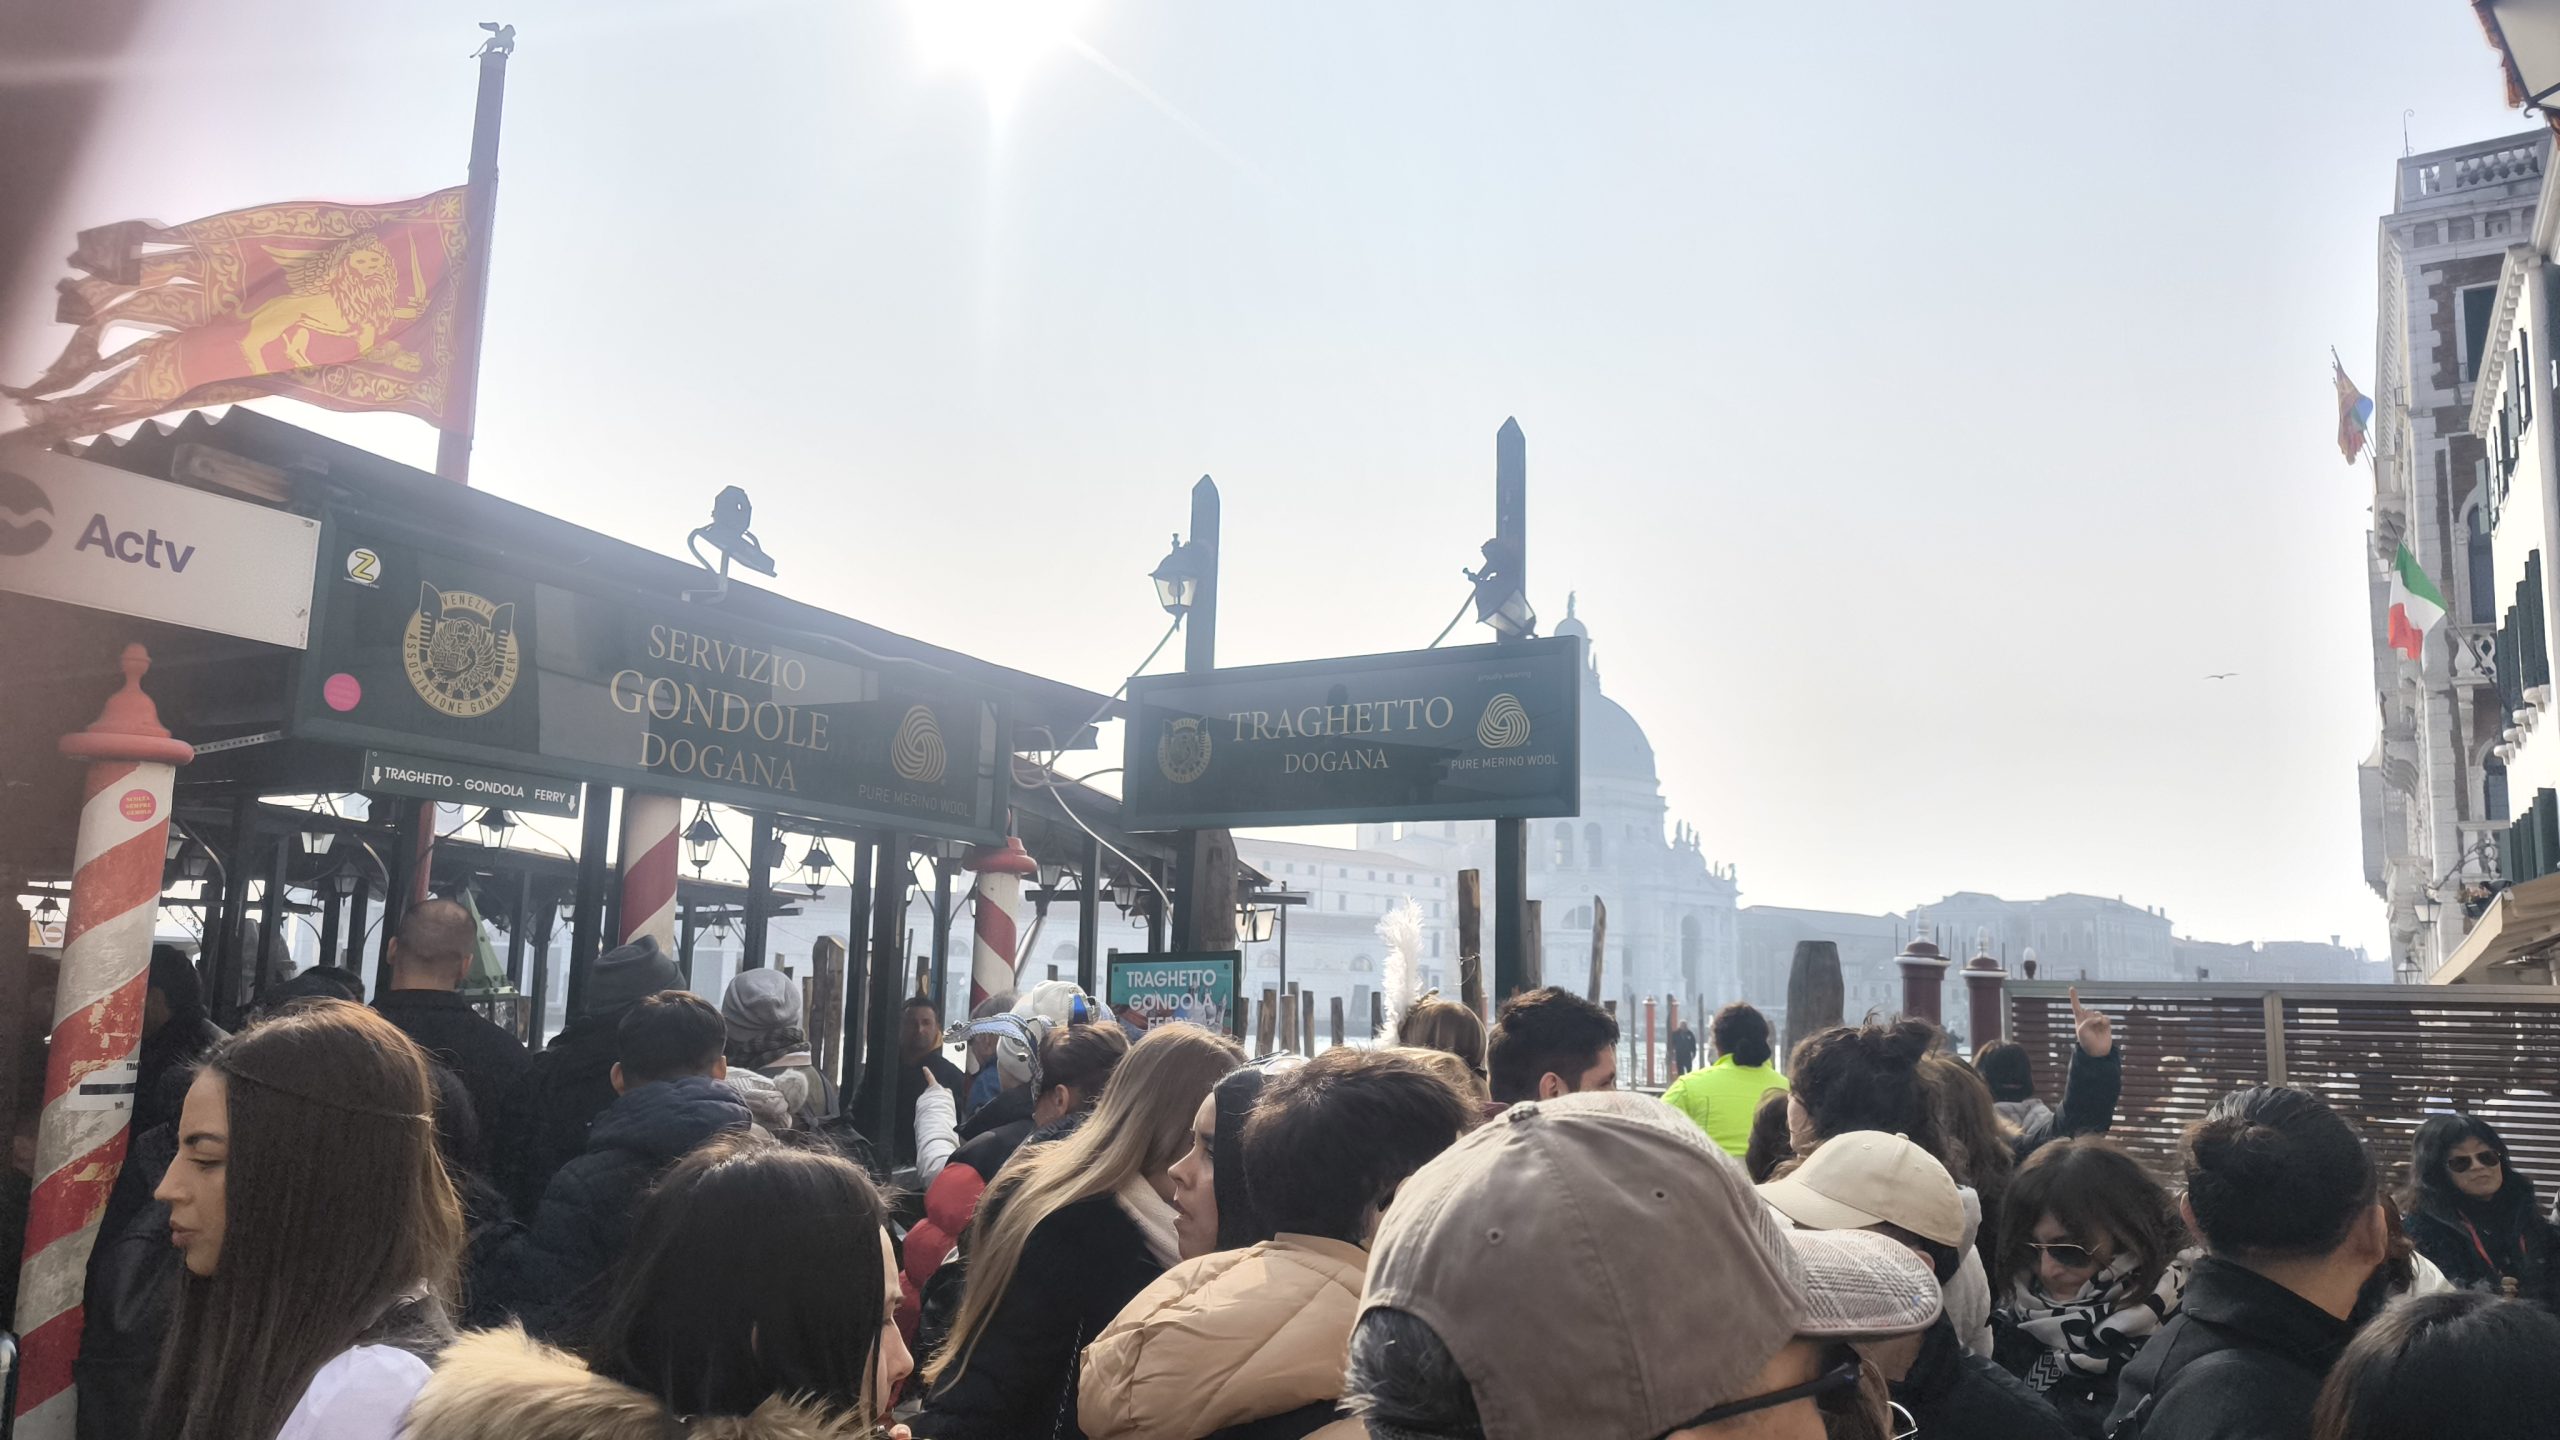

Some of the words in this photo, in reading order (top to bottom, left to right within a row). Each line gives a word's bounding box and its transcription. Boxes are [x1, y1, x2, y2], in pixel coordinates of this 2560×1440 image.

[74, 513, 196, 573] Actv
[442, 594, 494, 618] VENEZIA
[407, 633, 463, 714] ASSOCIAZIONE
[470, 651, 516, 713] GONDOLIERI
[648, 624, 806, 692] SERVIZIO
[610, 669, 831, 752] GONDOLE
[1229, 696, 1454, 742] TRAGHETTO
[637, 732, 798, 792] DOGANA
[1284, 748, 1389, 774] DOGANA
[1451, 758, 1479, 770] PURE
[1482, 756, 1524, 768] MERINO
[1527, 754, 1559, 766] WOOL
[385, 766, 453, 787] TRAGHETTO
[464, 779, 524, 798] GONDOLA
[535, 788, 566, 804] FERRY
[858, 784, 890, 803] PURE
[894, 791, 938, 810] MERINO
[940, 798, 970, 817] WOOL
[1126, 969, 1217, 988] TRAGHETTO
[1128, 993, 1217, 1011] GONDOLA
